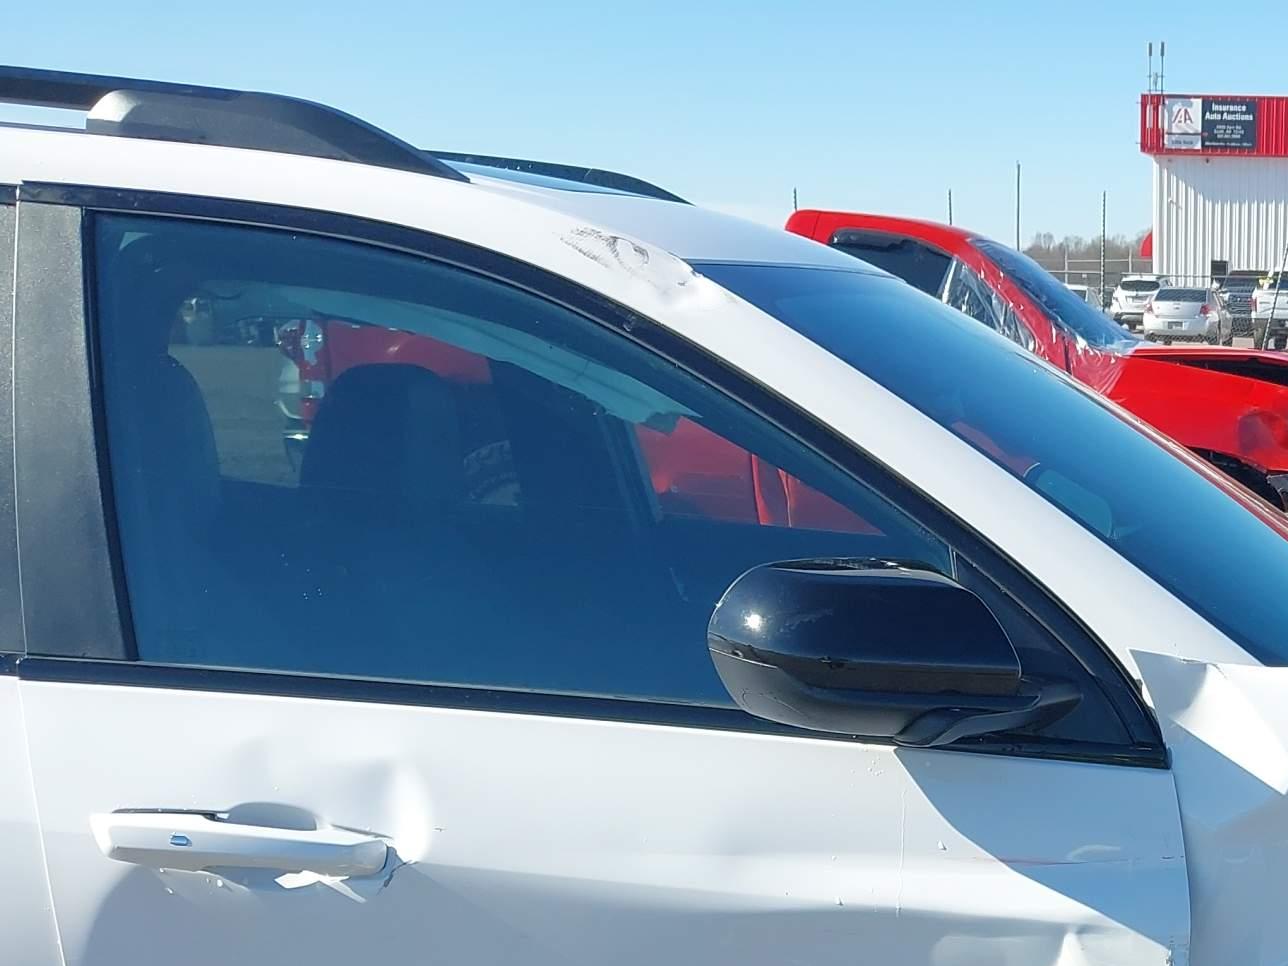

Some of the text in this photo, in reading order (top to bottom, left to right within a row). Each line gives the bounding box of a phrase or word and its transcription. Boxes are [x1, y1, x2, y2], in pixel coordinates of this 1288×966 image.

[1212, 103, 1246, 112] Insurance
[1205, 111, 1254, 121] Auto Auctions
